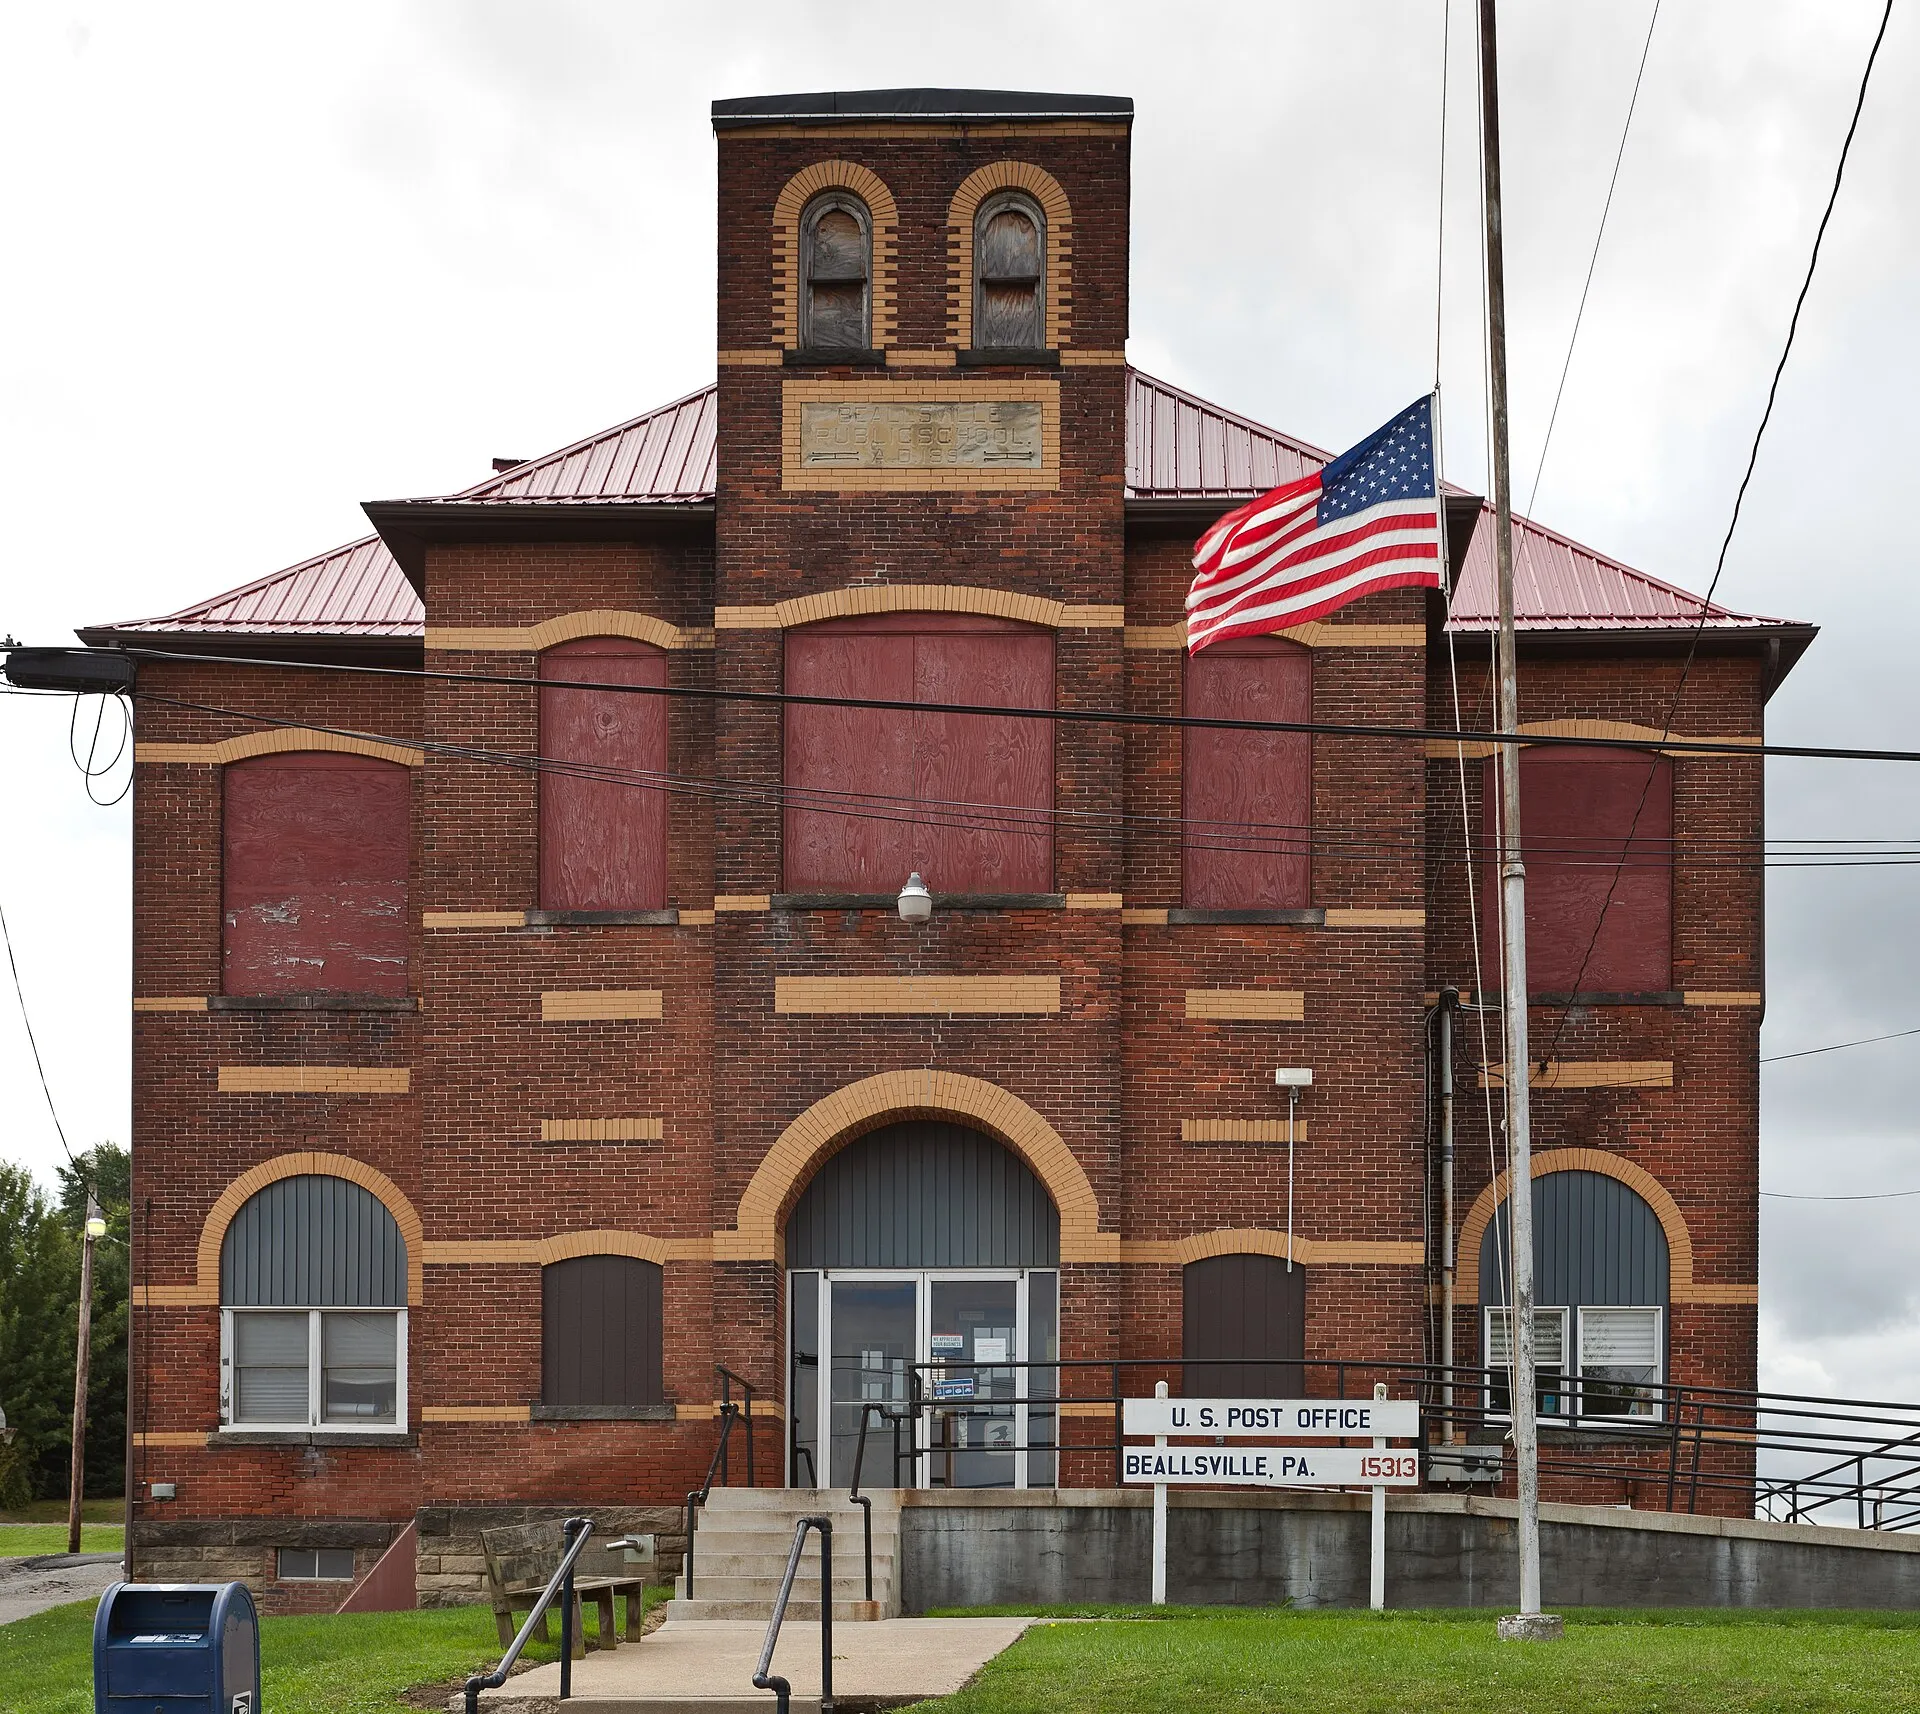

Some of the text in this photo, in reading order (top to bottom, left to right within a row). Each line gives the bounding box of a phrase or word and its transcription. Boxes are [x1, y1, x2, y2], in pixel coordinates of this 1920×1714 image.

[837, 406, 1002, 424] BEALLSVILLE
[815, 427, 1033, 446] PUBLIC SCHOOL.
[1227, 1407, 1283, 1428] POST
[1297, 1408, 1371, 1429] OFFICE
[1125, 1455, 1416, 1480] BEALLSVILLE, PA. 15313
